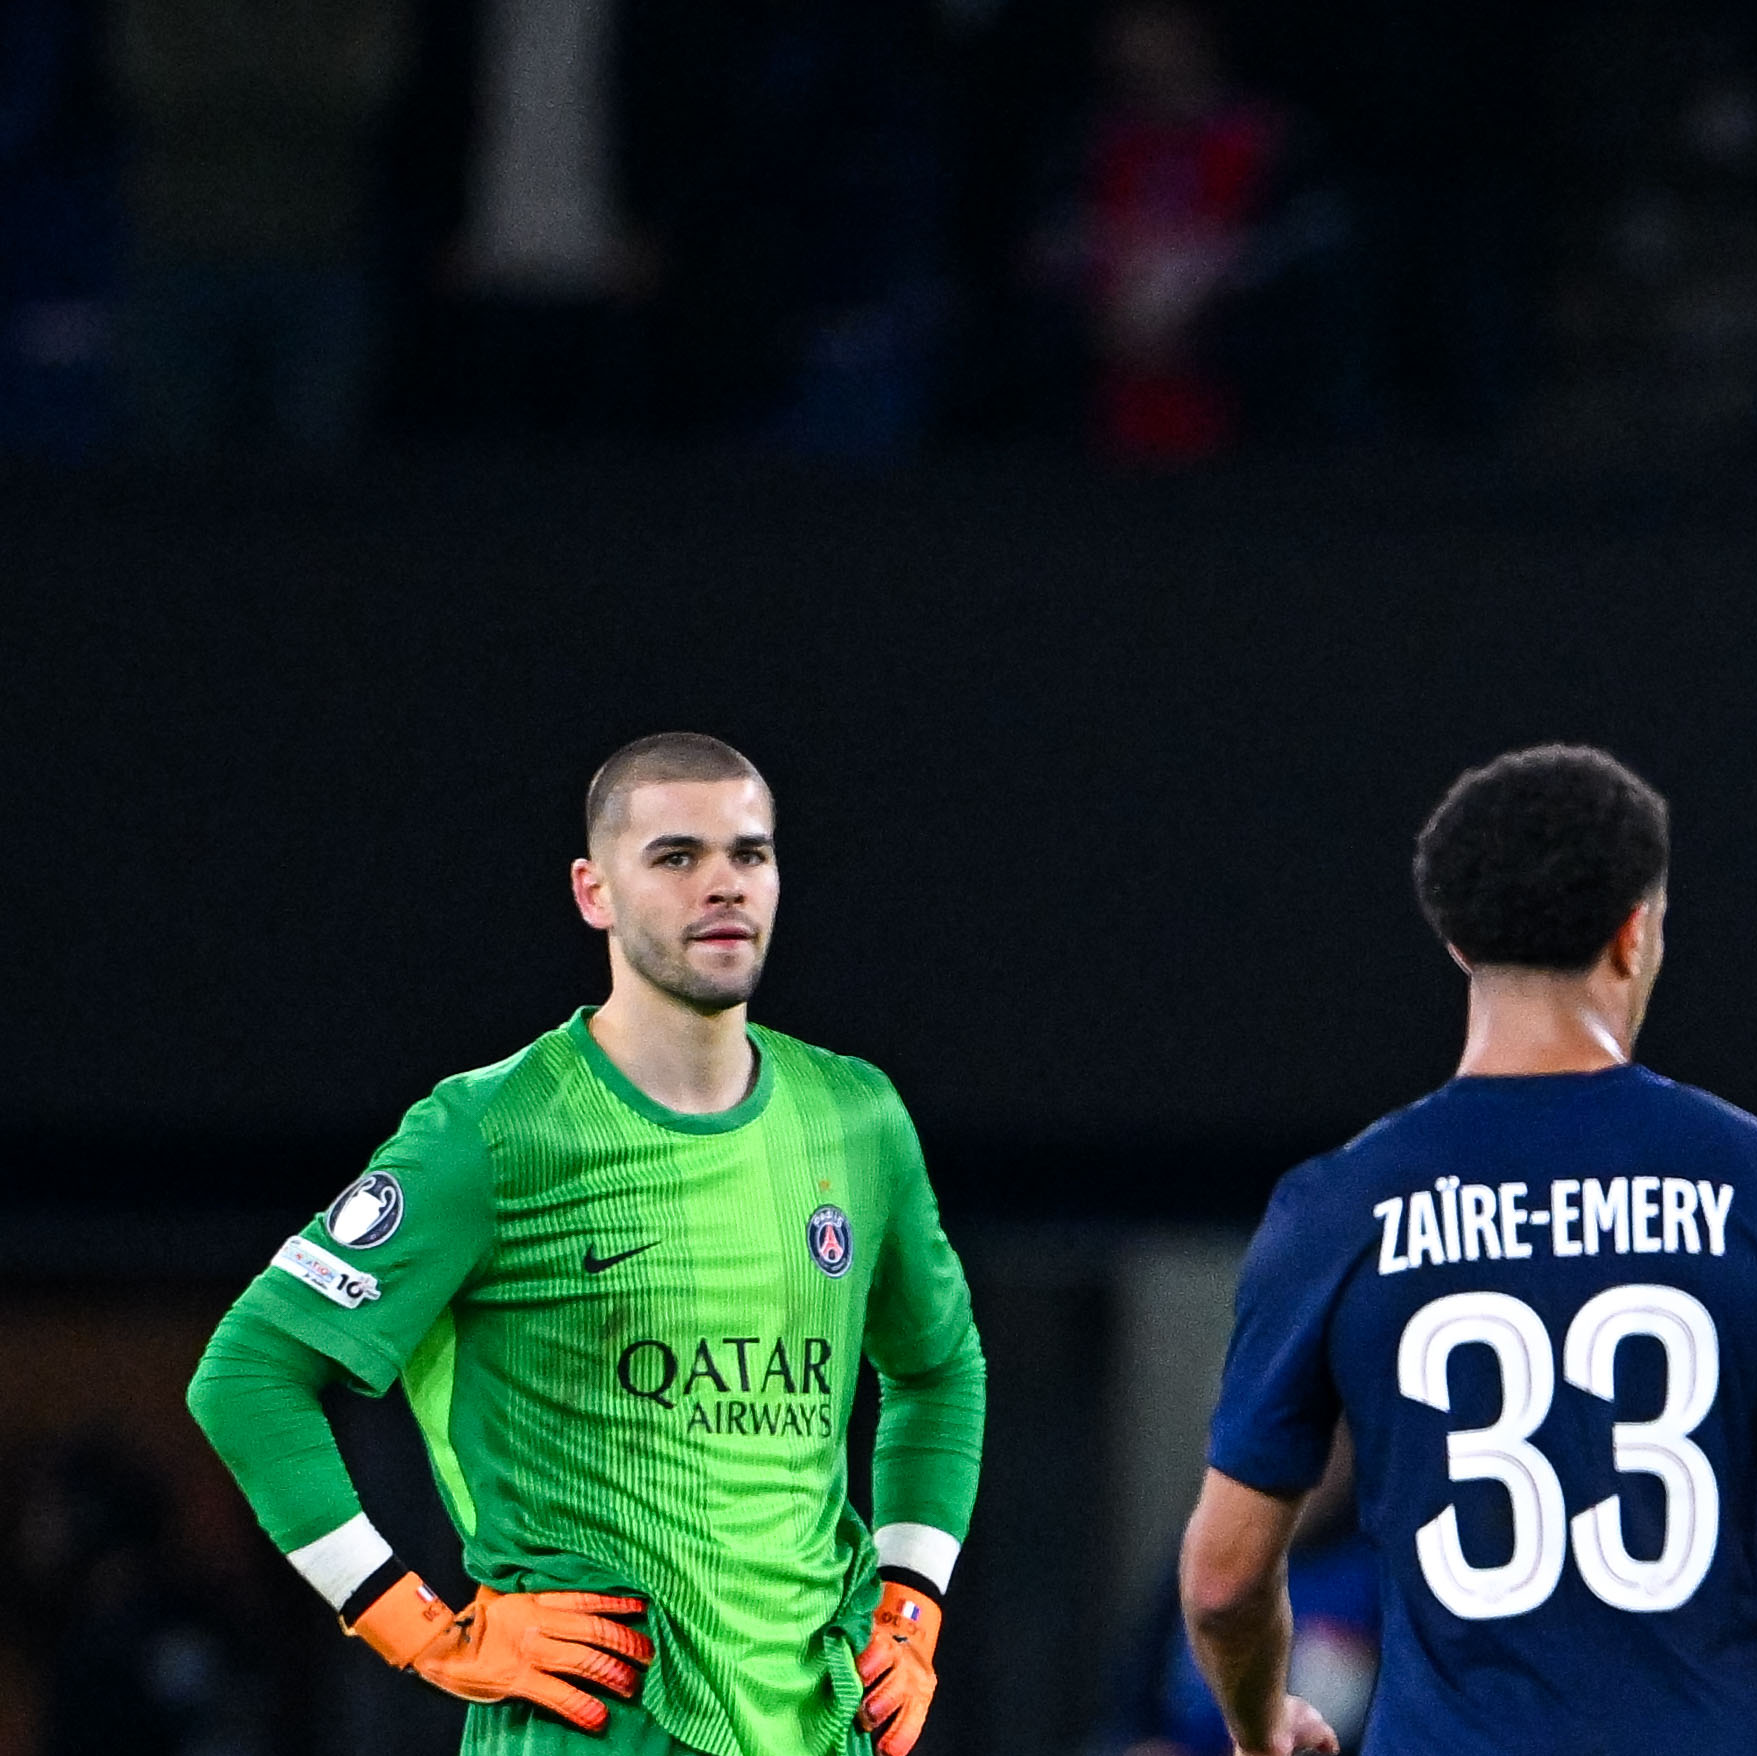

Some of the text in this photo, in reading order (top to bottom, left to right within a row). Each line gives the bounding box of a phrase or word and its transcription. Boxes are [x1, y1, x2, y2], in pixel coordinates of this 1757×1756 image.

[1374, 1175, 1734, 1276] ZAÏRE-EMERY
[617, 1337, 832, 1409] QATAR
[686, 1401, 832, 1438] AIRWAYS
[1397, 1284, 1719, 1620] 33
